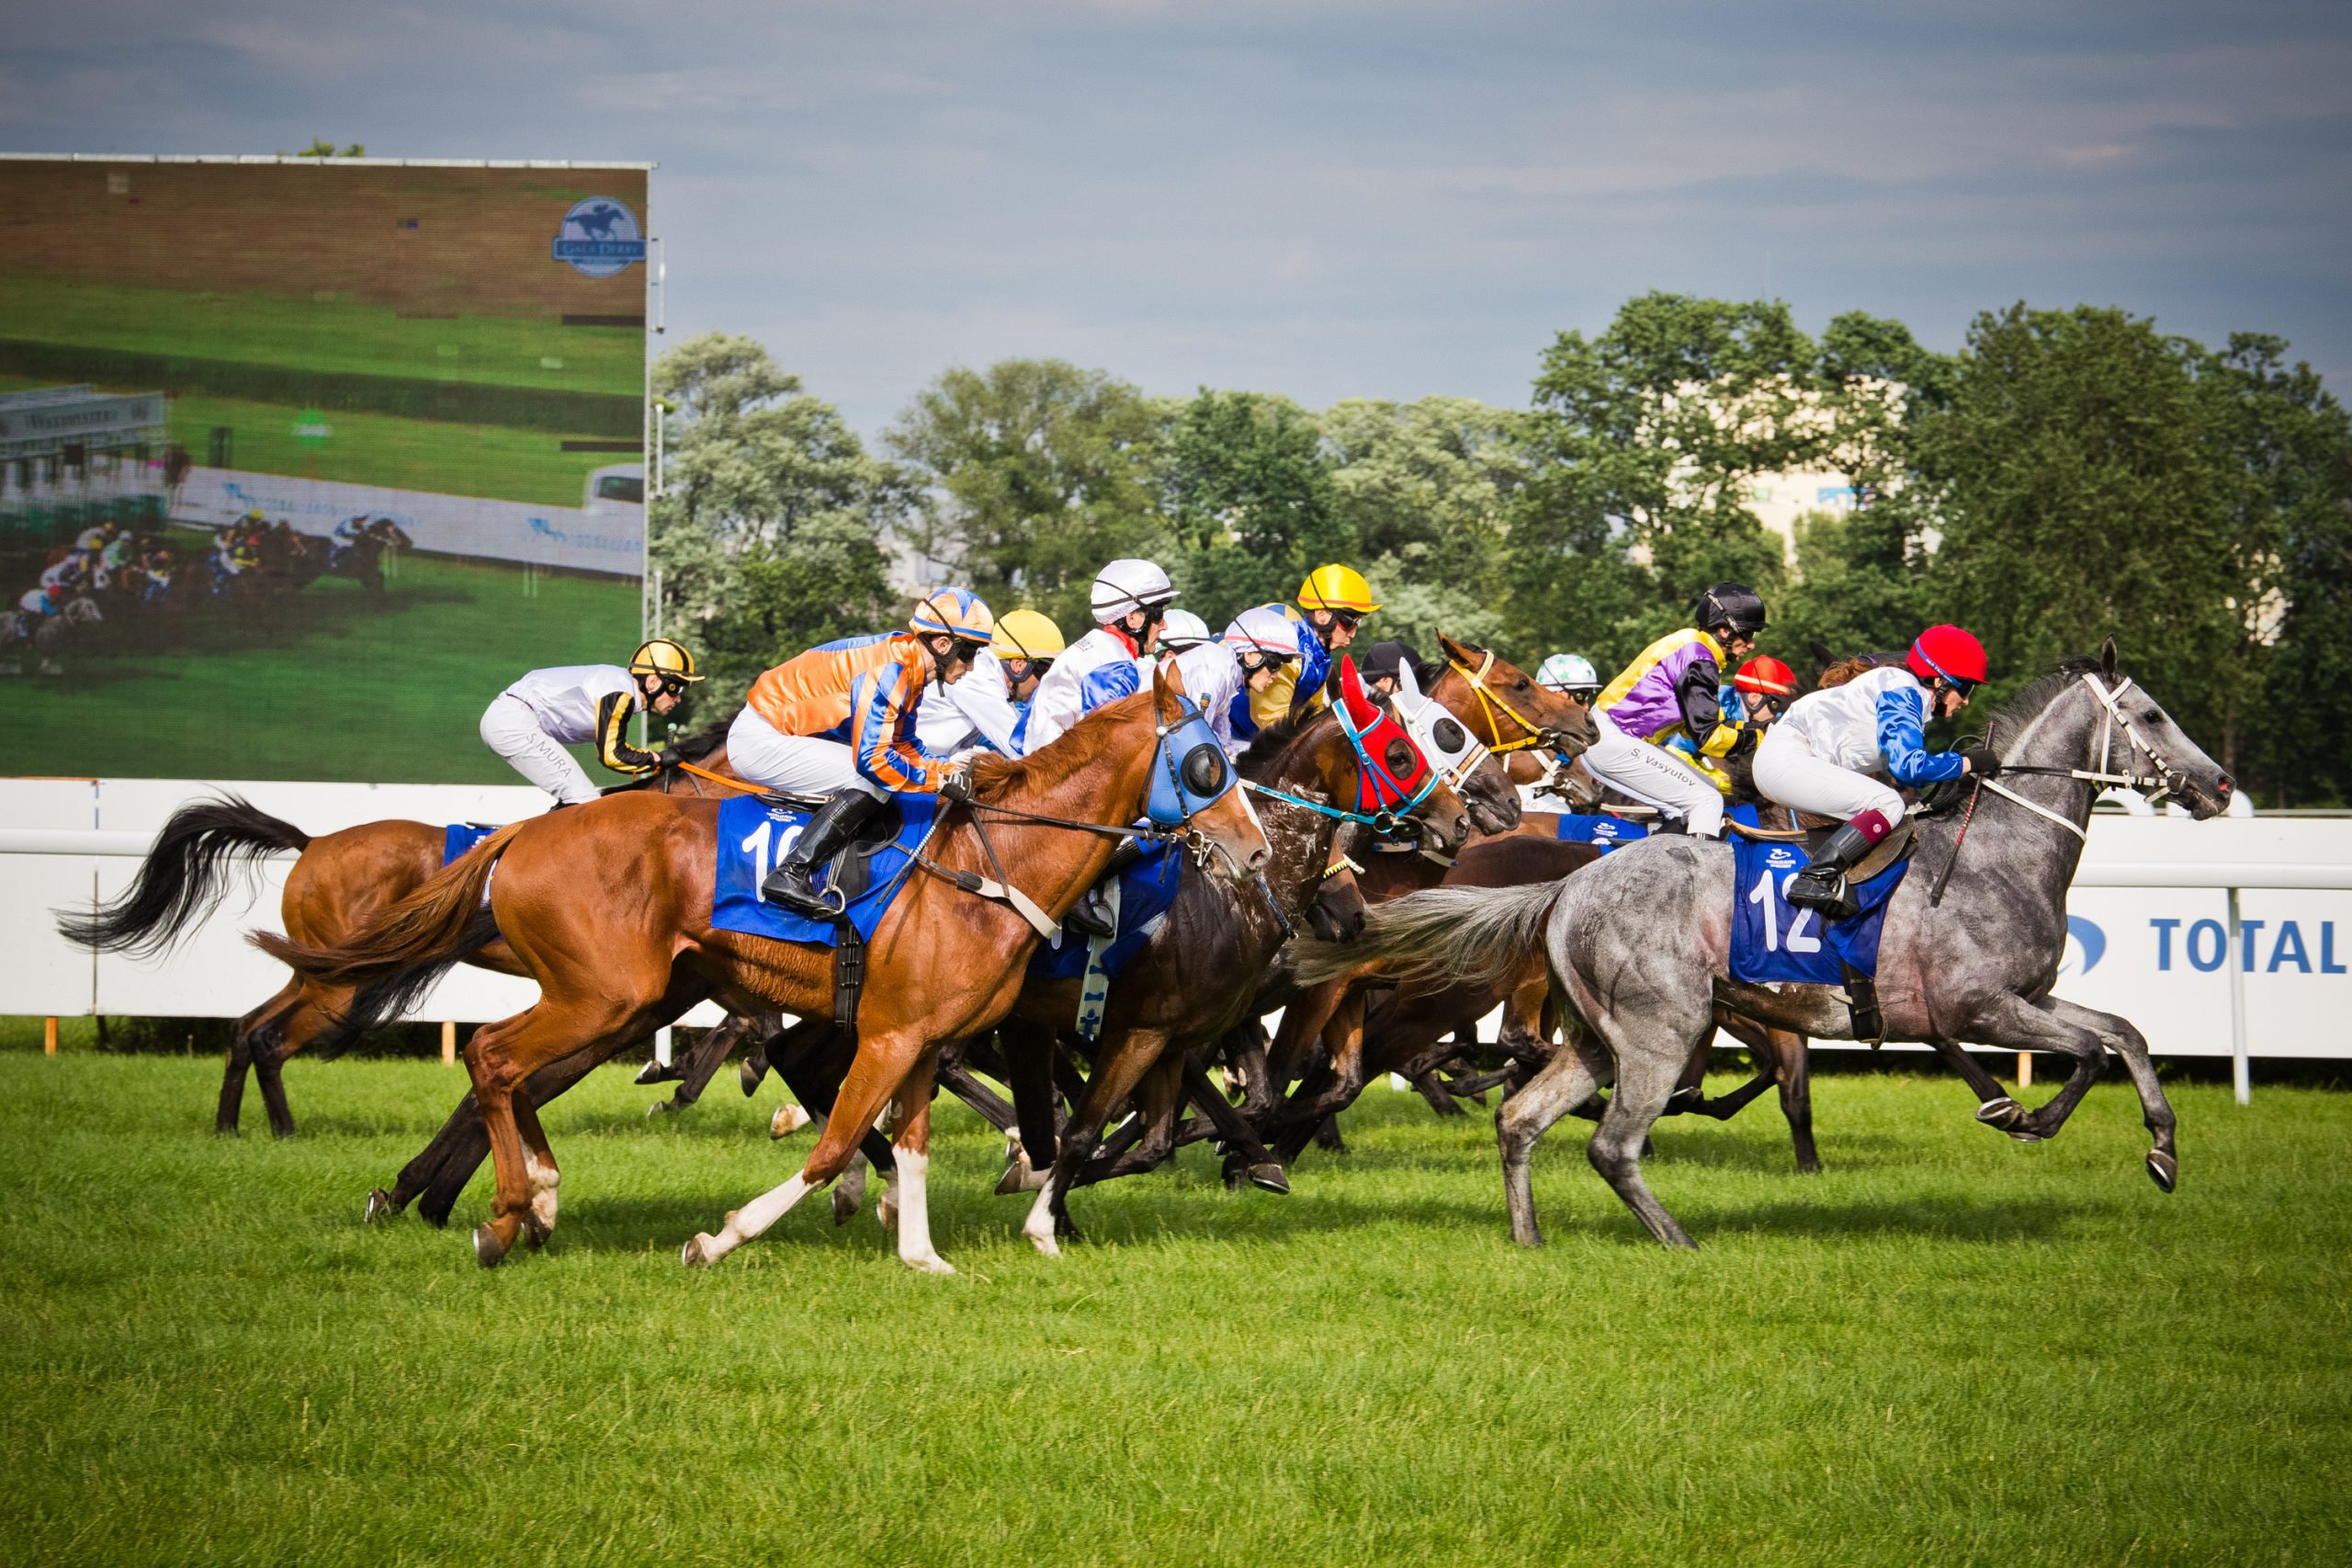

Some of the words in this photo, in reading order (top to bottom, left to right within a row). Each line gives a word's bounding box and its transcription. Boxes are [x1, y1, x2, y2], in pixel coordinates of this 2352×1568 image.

[536, 740, 572, 778] MURA
[1631, 748, 1641, 760] S.
[1645, 755, 1697, 787] Vasyutov
[1748, 869, 1822, 953] 12
[2149, 919, 2347, 974] TOTAL
